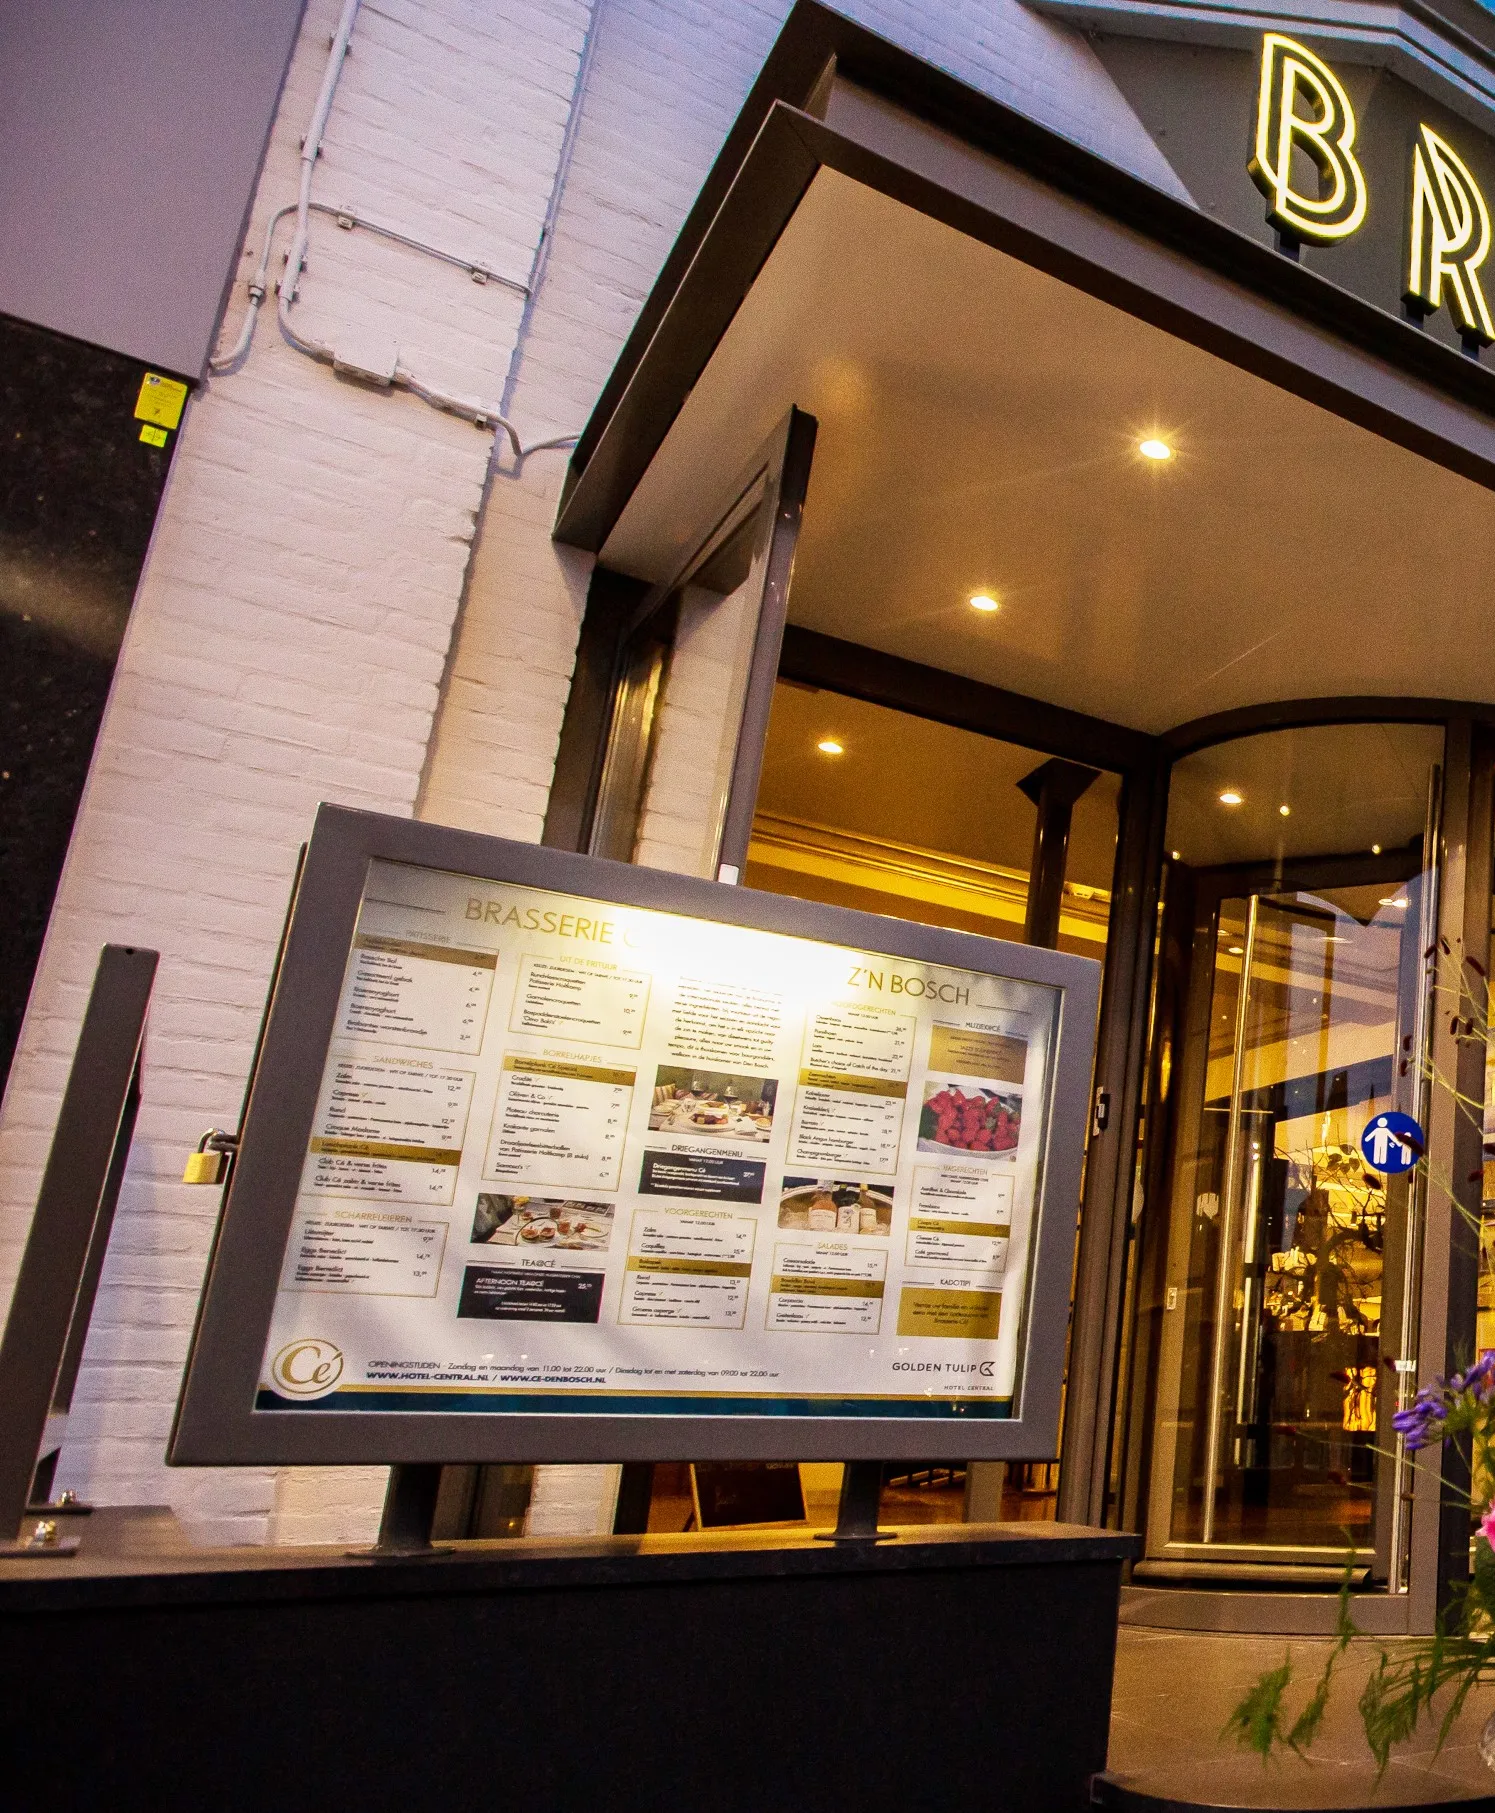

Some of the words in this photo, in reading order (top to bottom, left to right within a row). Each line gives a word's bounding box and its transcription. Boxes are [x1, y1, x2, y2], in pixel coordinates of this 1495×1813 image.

[465, 897, 616, 945] BRASSERIE
[405, 929, 451, 943] PATISSERIE
[560, 955, 572, 964] UIT
[574, 958, 585, 966] DE
[586, 959, 618, 971] FRITUUR
[847, 966, 884, 991] Z'N
[891, 974, 970, 1005] BOSCH
[372, 1055, 434, 1069] SANDWICHES
[543, 1049, 602, 1063] BORRELHAPJES
[671, 1144, 743, 1157] DRIEGANGENMENU
[335, 1210, 412, 1223] SCHARRELEIEREN
[664, 1208, 733, 1219] VOORGERECHTEN
[817, 1242, 848, 1250] SALADES
[521, 1259, 556, 1268] TEA@CÉ
[280, 1344, 343, 1385] Cé
[368, 1360, 441, 1370] OPENINGSTIJDEN
[447, 1362, 477, 1372] Zondag
[489, 1365, 525, 1373] maandag
[892, 1363, 941, 1372] GOLDEN
[945, 1364, 977, 1372] TULIP
[366, 1371, 489, 1382] WWW.HOTEL-CENTRAL.NL
[500, 1374, 606, 1383] WWW.CE-DENBOSCH.NL
